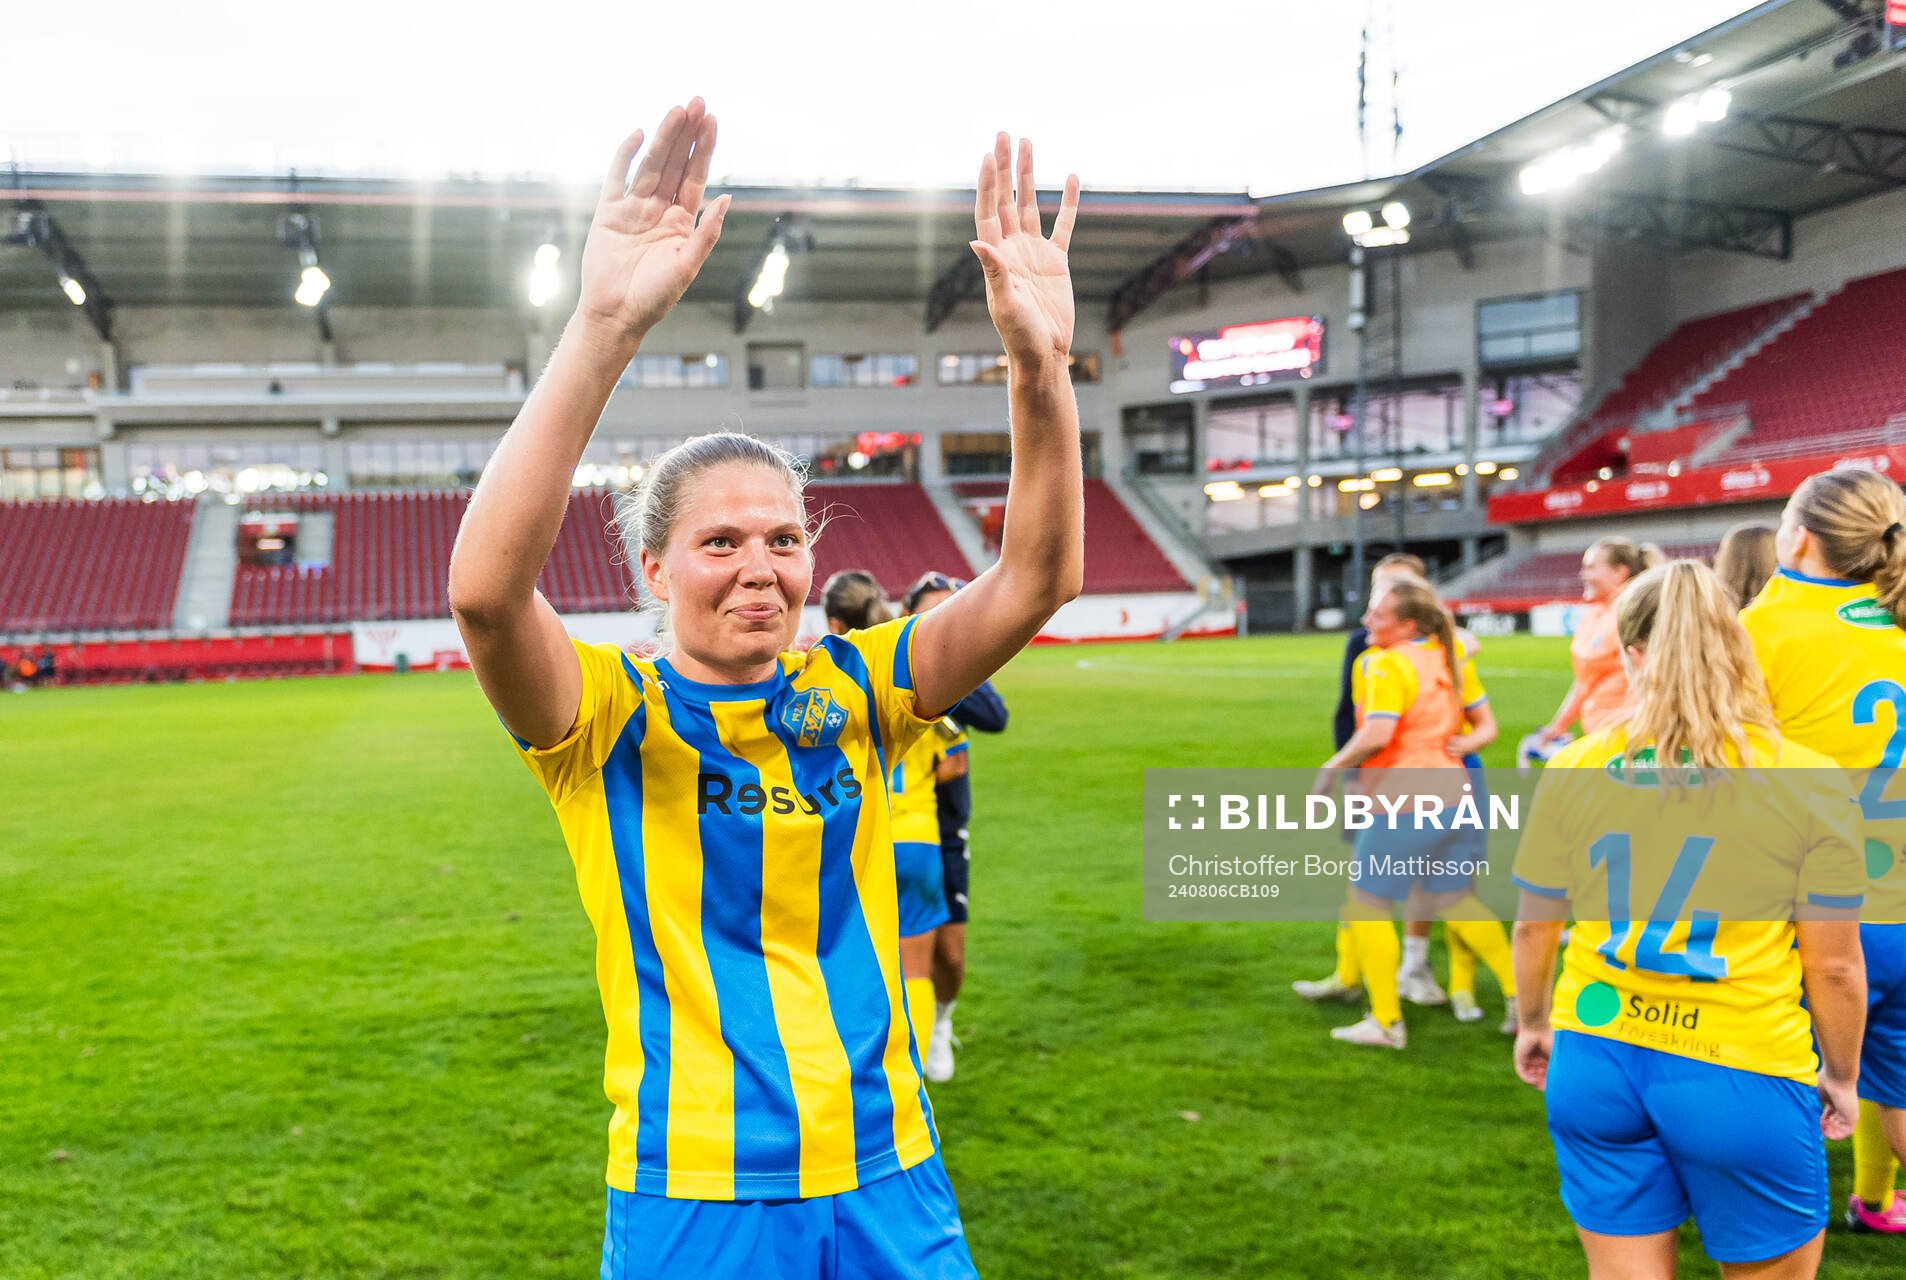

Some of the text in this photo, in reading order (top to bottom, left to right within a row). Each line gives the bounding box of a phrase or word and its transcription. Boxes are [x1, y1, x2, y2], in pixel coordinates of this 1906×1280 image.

[697, 768, 862, 815] Resurs
[1588, 832, 1728, 982] 14
[1626, 995, 1699, 1030] Solid
